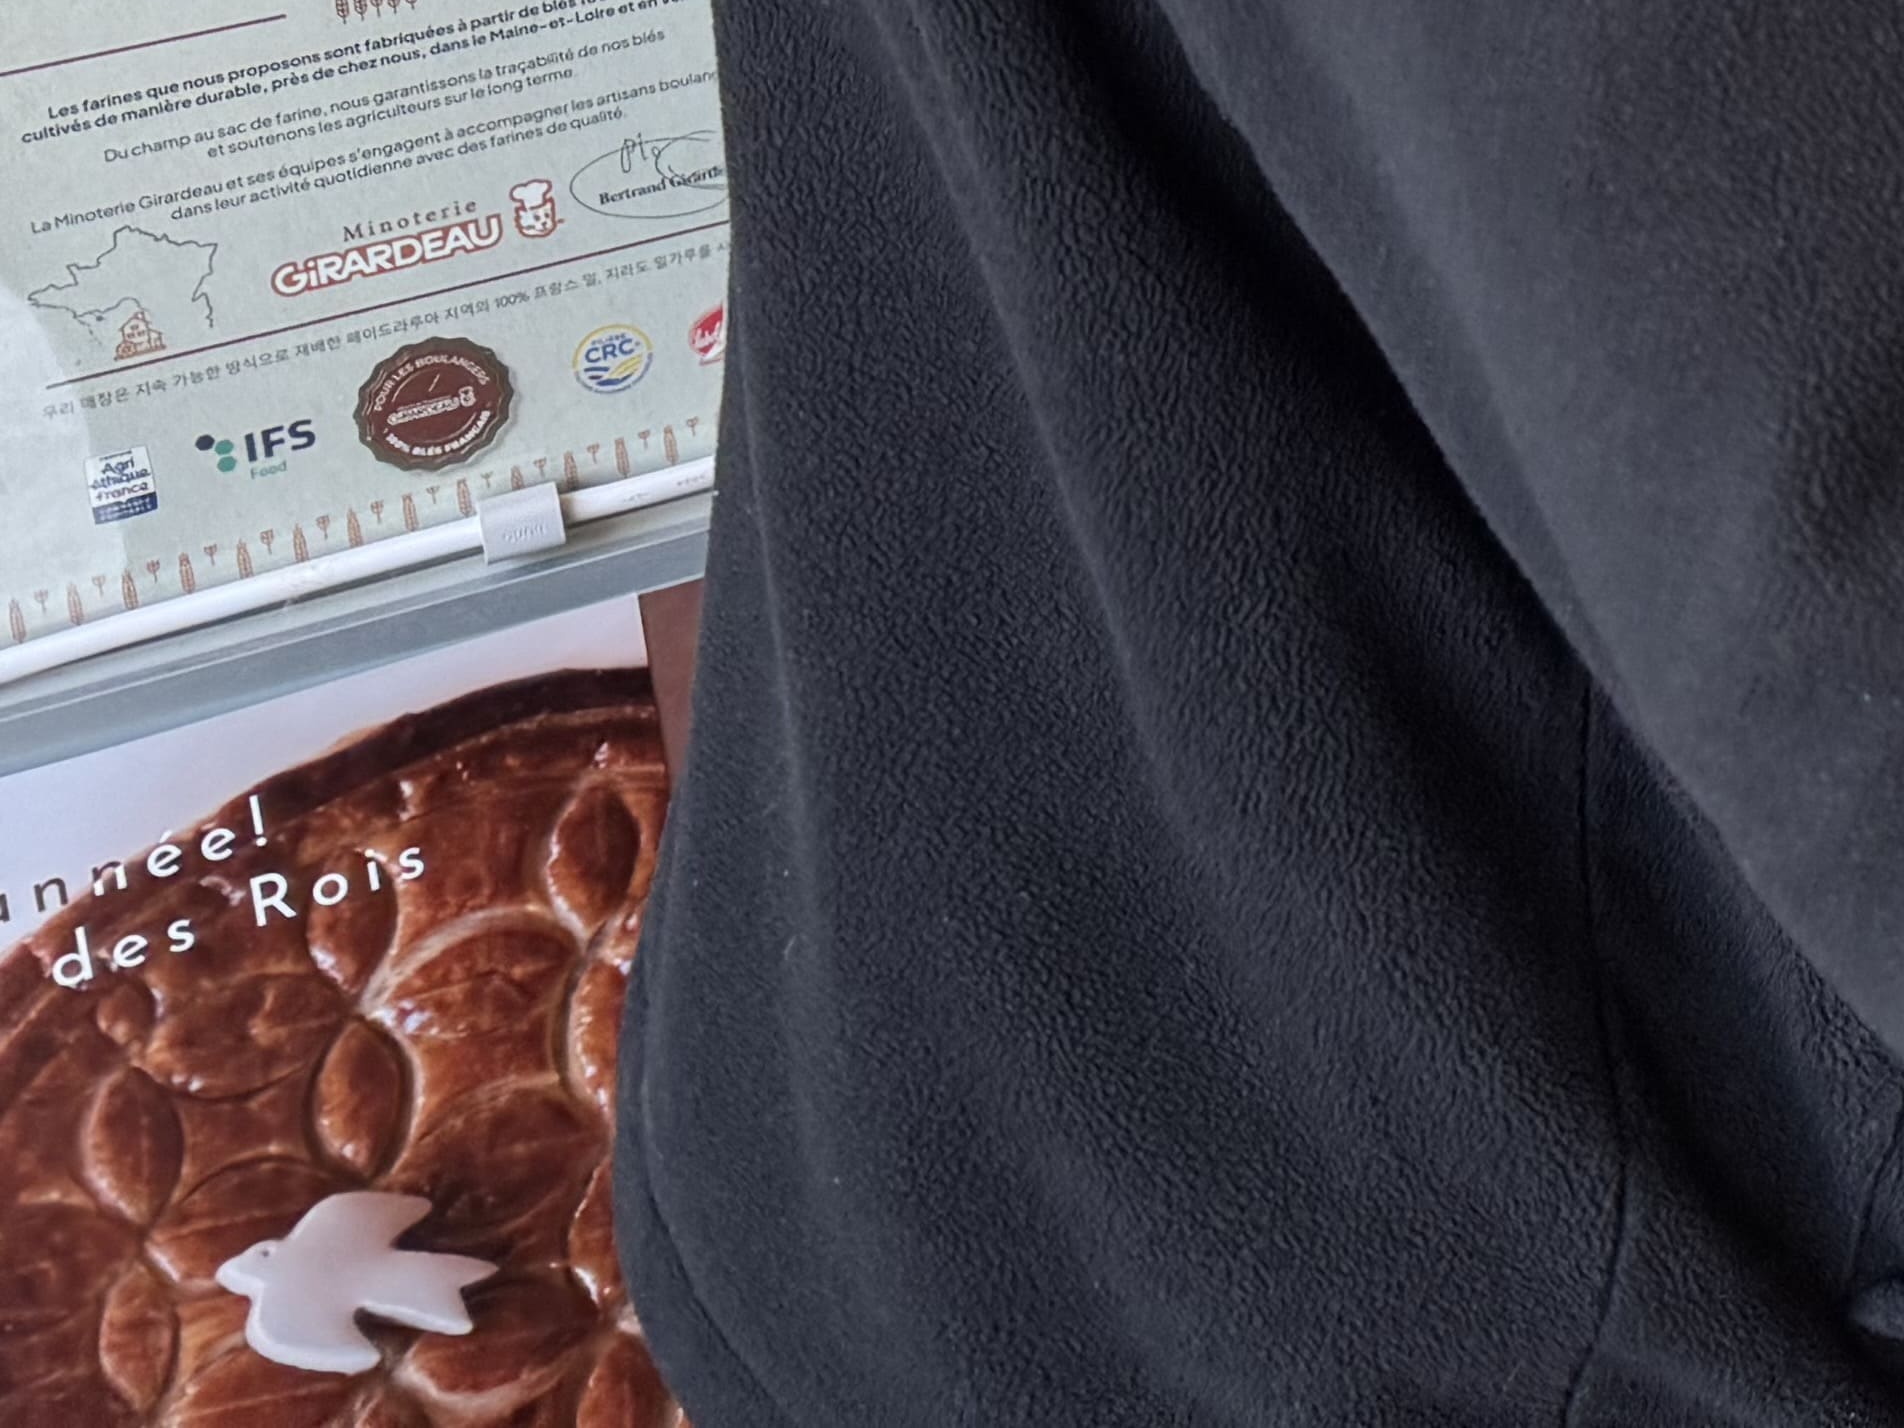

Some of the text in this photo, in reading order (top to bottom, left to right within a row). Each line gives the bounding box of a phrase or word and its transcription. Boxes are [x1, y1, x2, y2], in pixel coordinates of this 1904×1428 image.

[48, 100, 79, 120] Les
[82, 87, 142, 113] farines
[146, 81, 178, 102] que
[183, 72, 224, 92] nous
[228, 51, 320, 84] proposons
[324, 42, 361, 62] sont
[364, 20, 453, 55] fabriquées
[458, 17, 466, 33] à
[470, 7, 514, 32] partir
[518, 2, 538, 20] de
[599, 178, 665, 206] Bertrand
[343, 195, 477, 243] Minoterie
[584, 339, 637, 366] CRC
[244, 418, 317, 463] IFS
[249, 459, 289, 480] Food
[52, 843, 425, 991] des Rois
